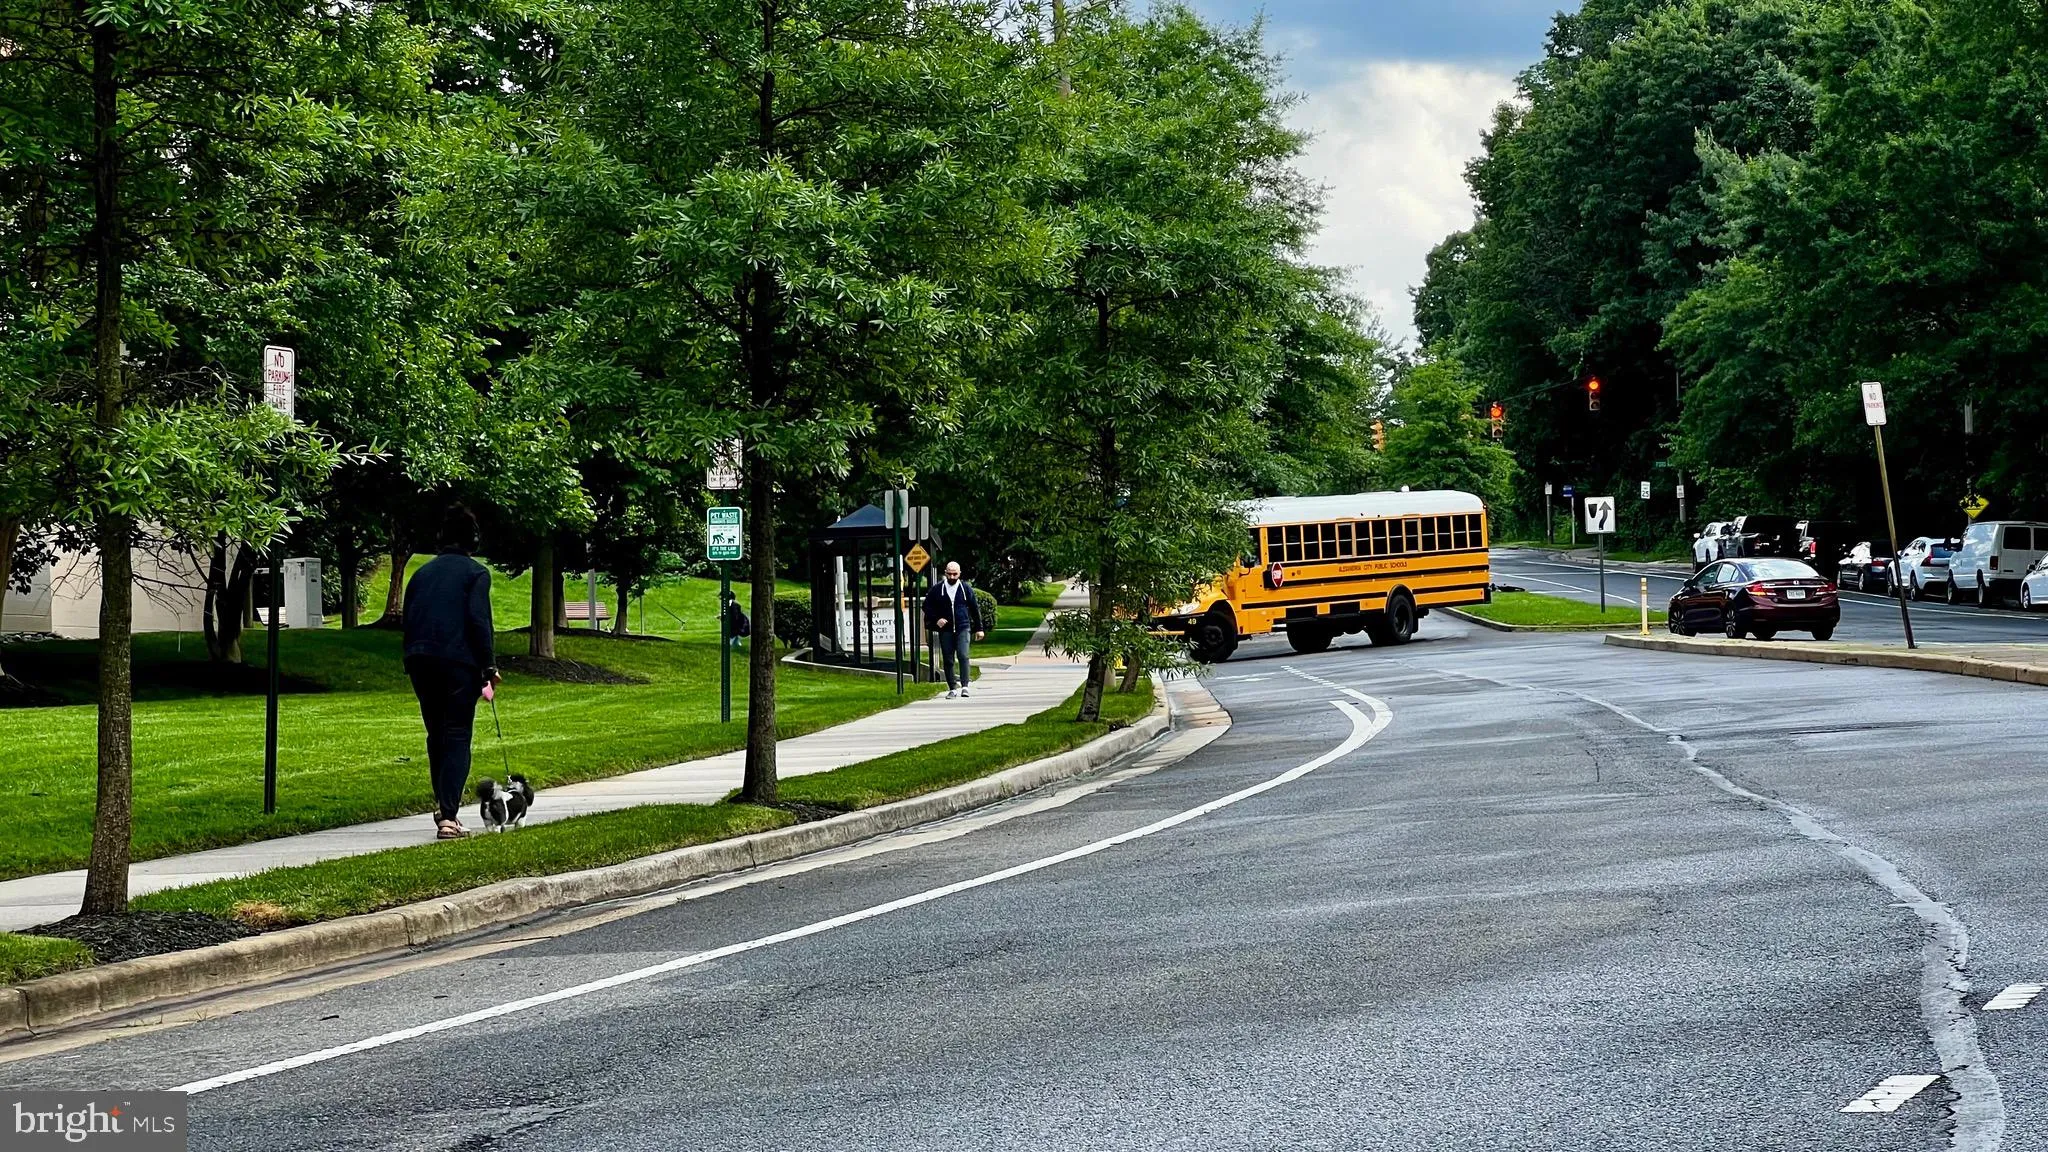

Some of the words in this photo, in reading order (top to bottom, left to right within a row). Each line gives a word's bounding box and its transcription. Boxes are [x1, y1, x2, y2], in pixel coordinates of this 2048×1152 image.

[274, 355, 285, 368] NO
[268, 369, 290, 383] PARKING
[273, 384, 285, 396] FIRE
[1869, 392, 1877, 401] NO
[1641, 490, 1649, 498] 25
